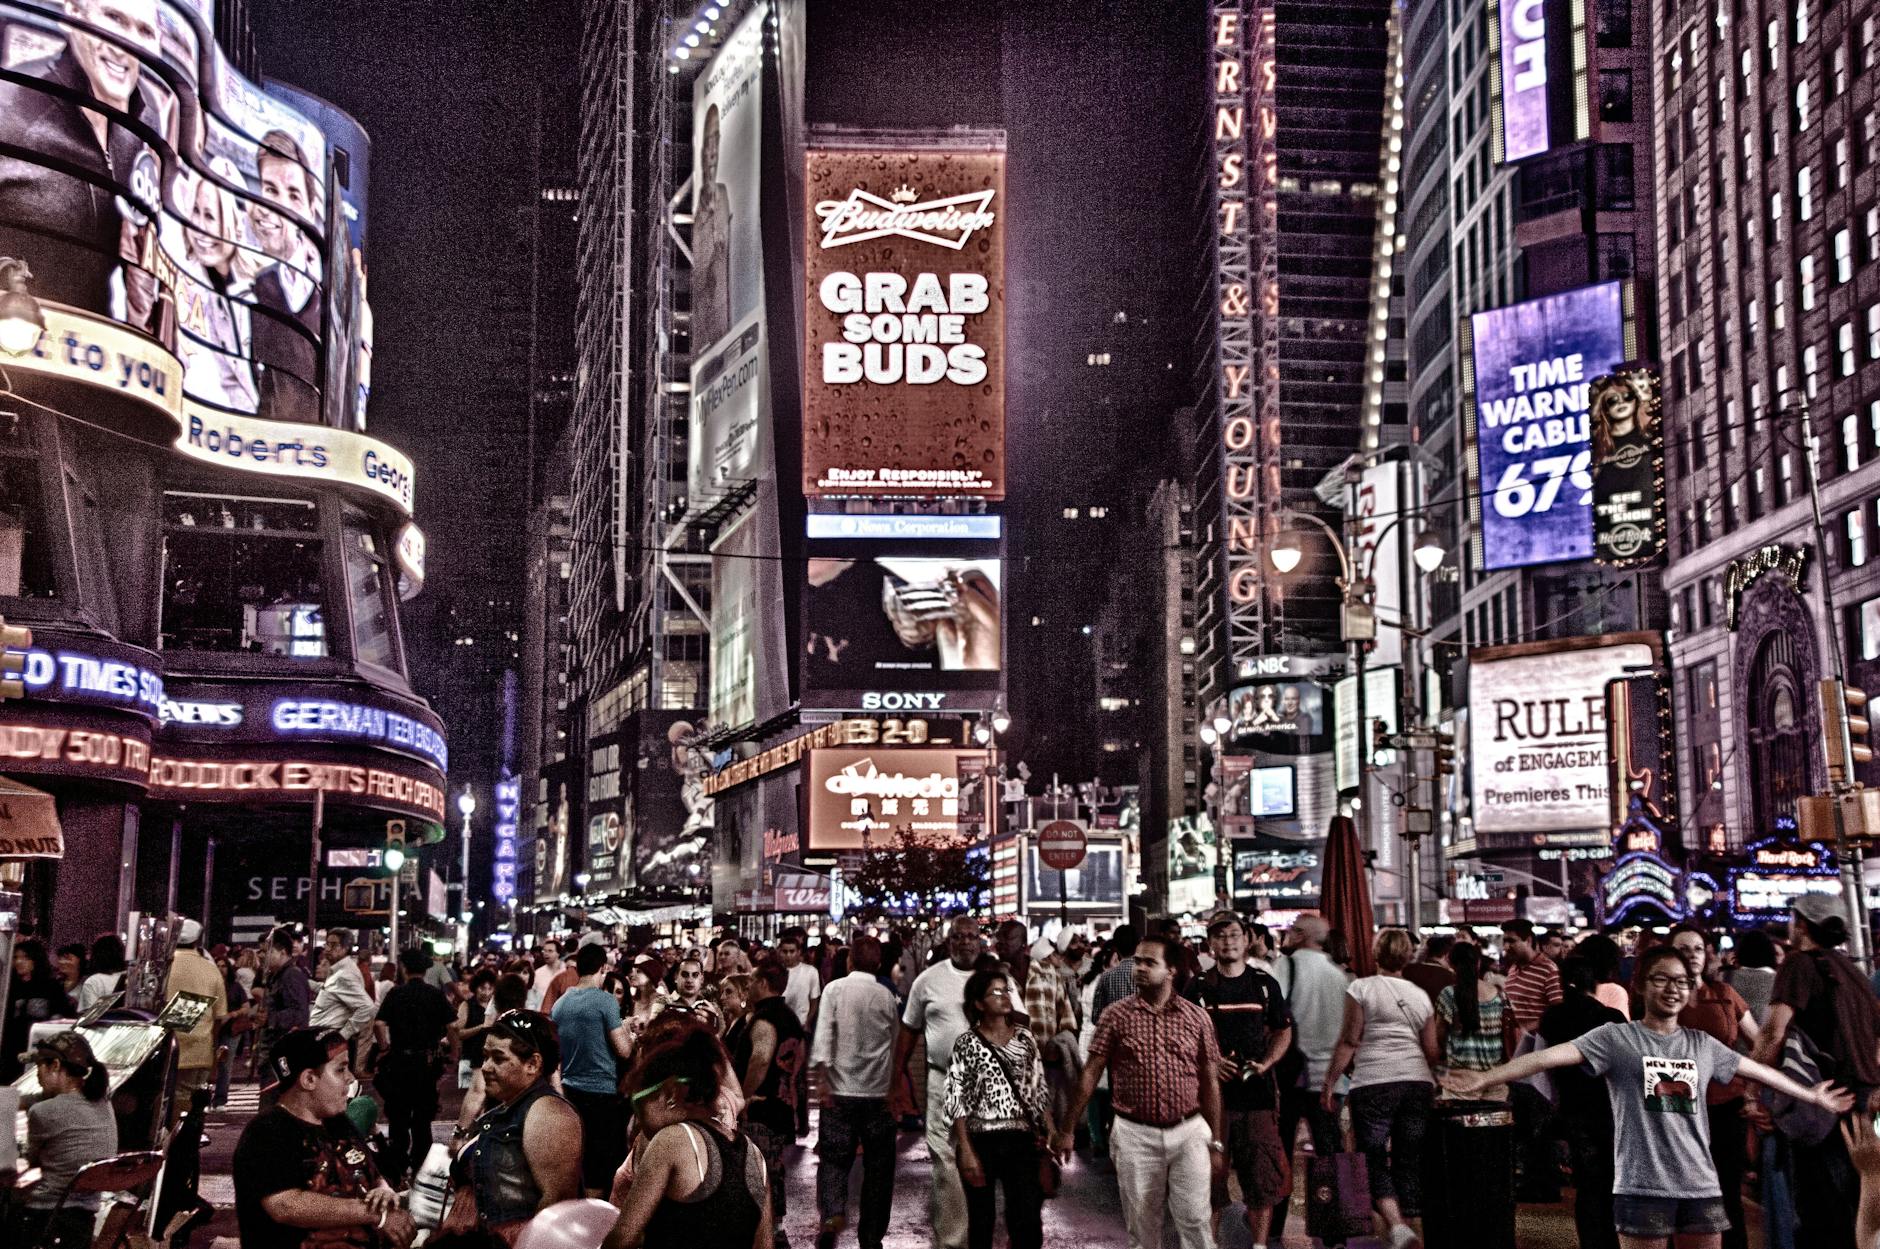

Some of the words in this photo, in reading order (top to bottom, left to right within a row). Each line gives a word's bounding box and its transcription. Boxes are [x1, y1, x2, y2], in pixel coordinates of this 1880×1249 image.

[1216, 14, 1243, 235] ERNST
[815, 200, 995, 233] Budweiser
[819, 271, 990, 315] GRAB
[1220, 284, 1249, 317] &
[843, 315, 966, 344] SOME
[61, 330, 109, 371] to
[118, 353, 167, 396] you
[822, 343, 988, 385] BUDS
[1509, 353, 1584, 393] TIME
[188, 415, 328, 468] Roberts
[828, 467, 876, 482] ENJOY
[1224, 365, 1257, 601] YOUNG
[1597, 503, 1627, 517] THE
[1609, 491, 1642, 504] SEE
[894, 520, 969, 536] Corporation
[1610, 507, 1652, 523] SHOW
[59, 655, 138, 698] TIMES
[1257, 655, 1290, 674] NBC
[862, 691, 946, 709] SONY
[272, 701, 386, 738] GERMAN
[1493, 695, 1606, 742] RULE
[66, 730, 121, 764] 500
[1494, 756, 1515, 773] of
[150, 757, 282, 791] RODDICK
[281, 762, 367, 793] EXITS
[367, 769, 414, 803] FRENCH
[1484, 787, 1571, 805] Premieres
[15, 837, 60, 854] NUTS
[1046, 830, 1059, 839] DO
[1061, 830, 1079, 839] NOT
[1050, 851, 1077, 861] ENTER
[1757, 850, 1788, 864] Hard
[1788, 850, 1816, 867] Rock
[247, 876, 423, 900] SEPHRA
[1646, 1060, 1666, 1068] NEW
[1670, 1062, 1694, 1070] YORK
